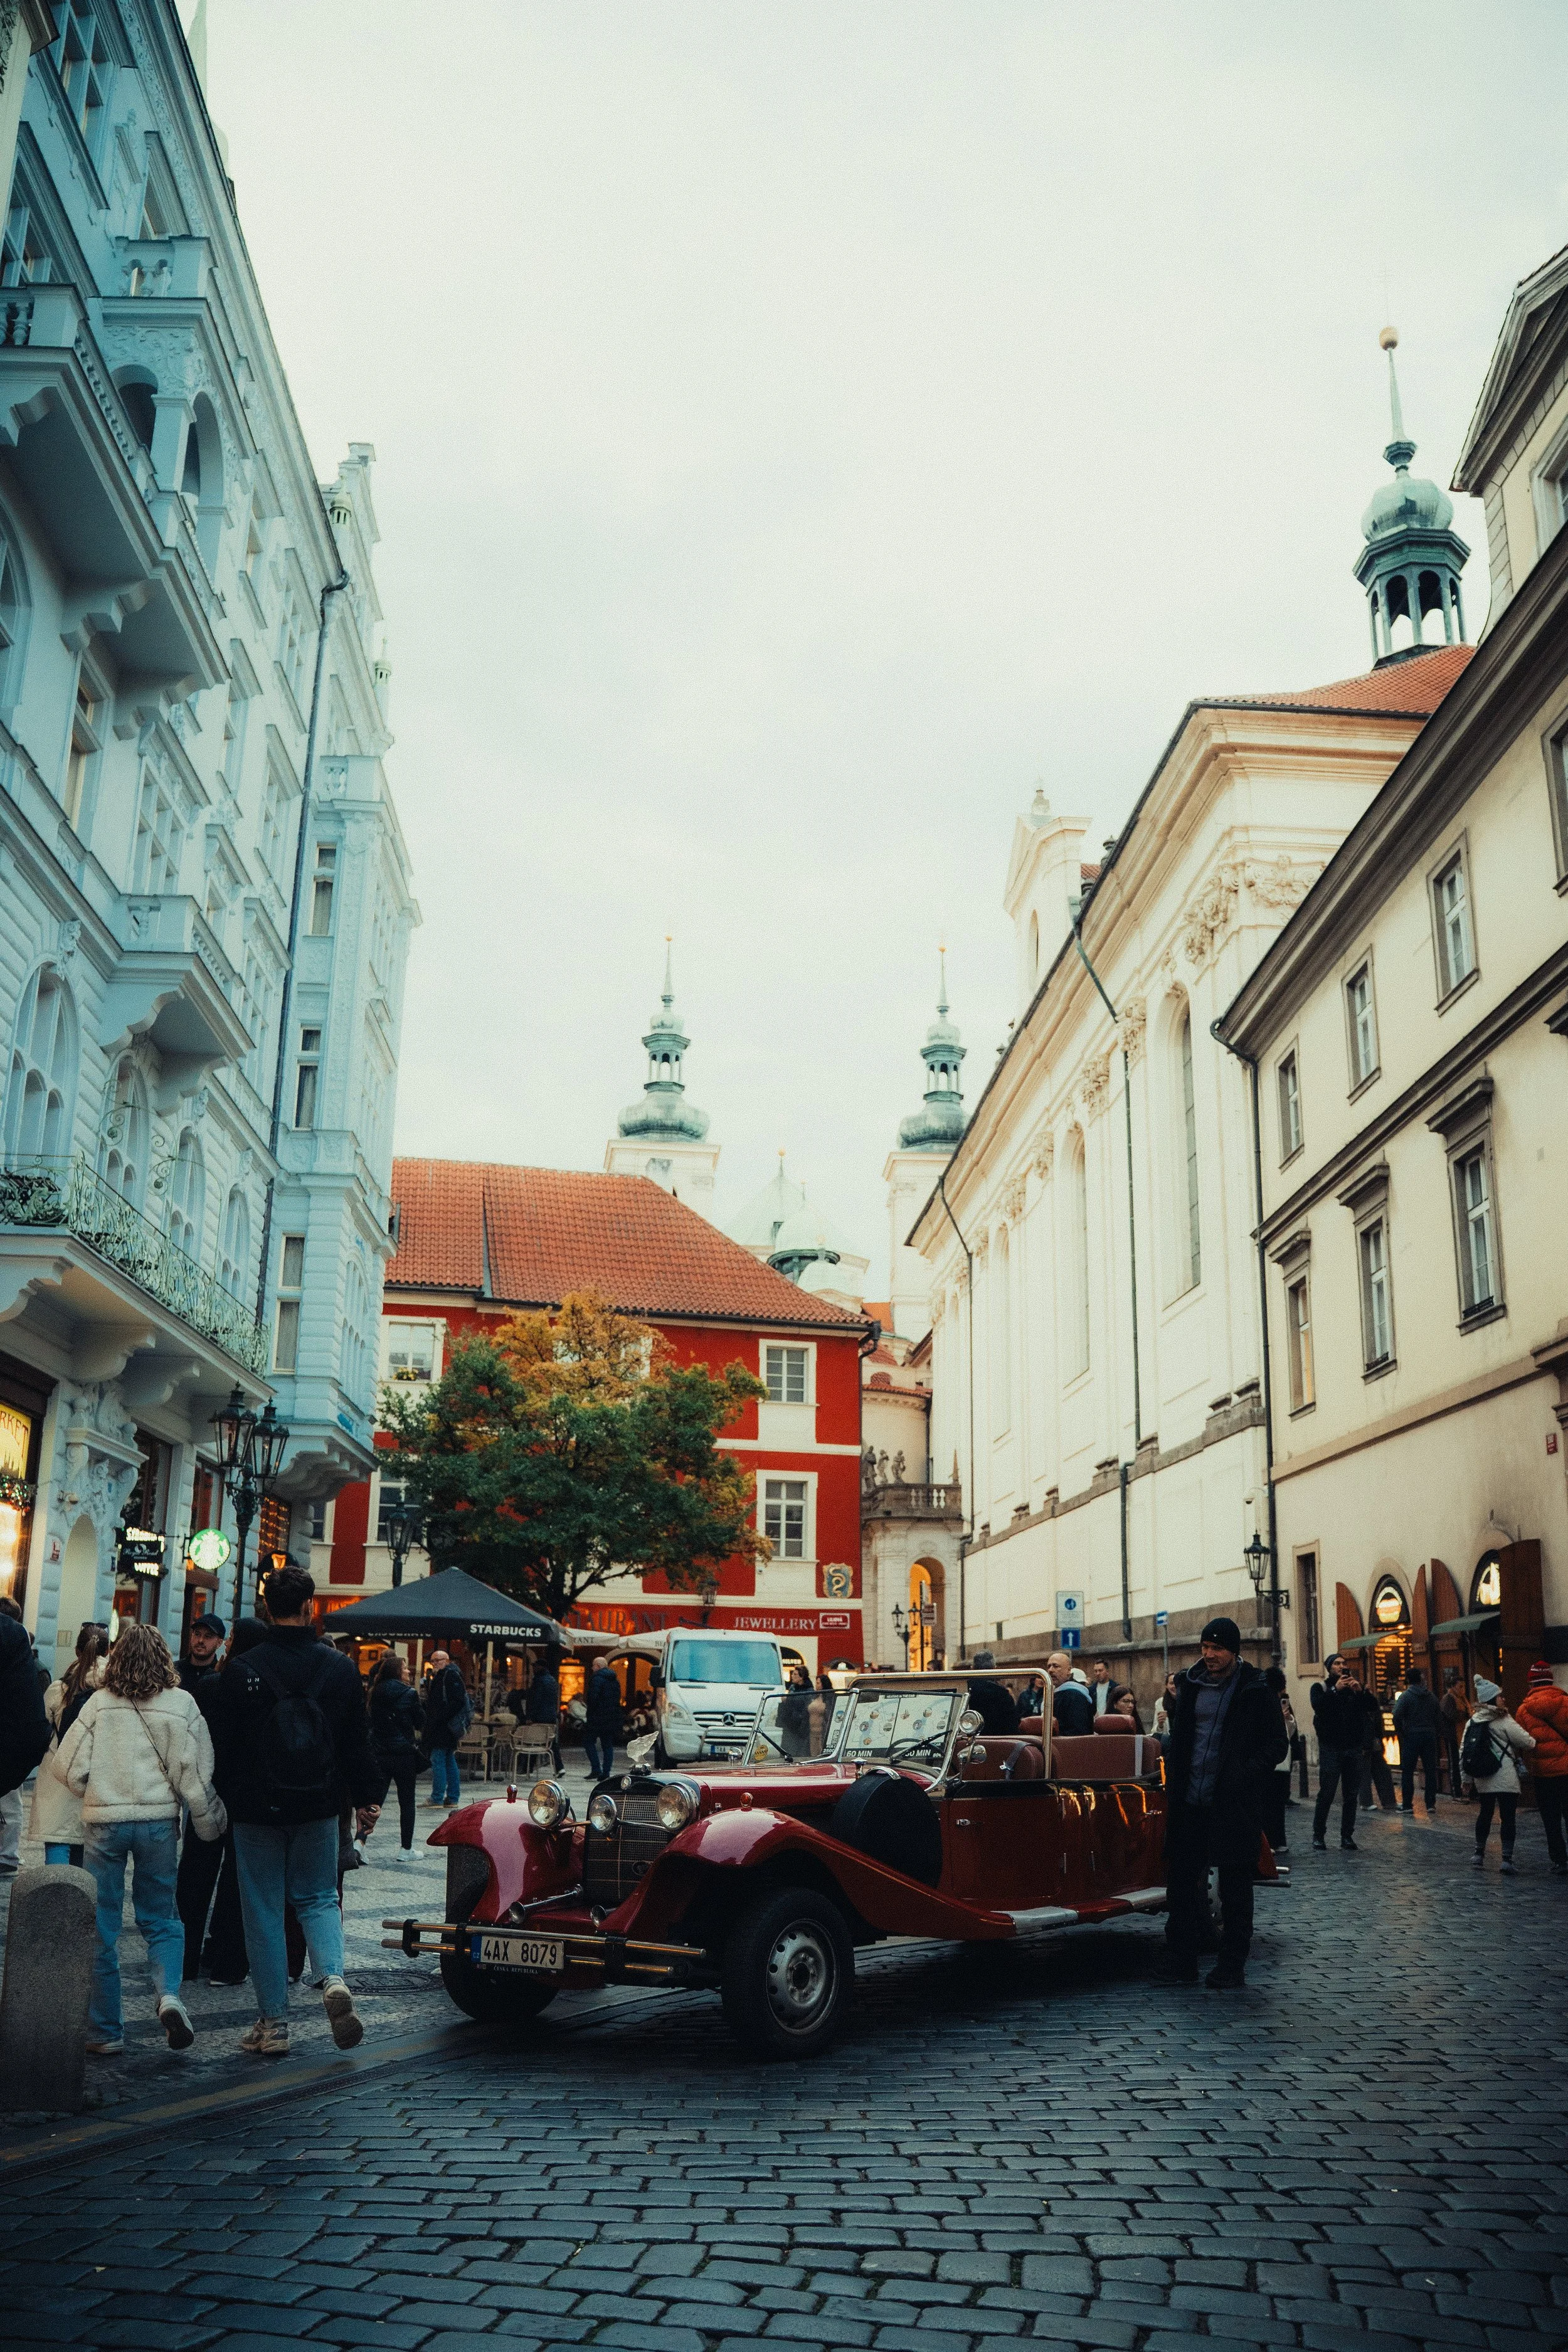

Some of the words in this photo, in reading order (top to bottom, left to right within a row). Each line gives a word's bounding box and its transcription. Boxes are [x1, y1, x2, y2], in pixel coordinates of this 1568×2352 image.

[0, 1410, 29, 1458] RKET
[470, 1624, 541, 1638] STARBUCKS
[563, 1611, 667, 1631] STAURANT
[734, 1616, 817, 1630] JEWELLERY
[484, 1939, 509, 1961] 4AX
[521, 1942, 558, 1966] 8079
